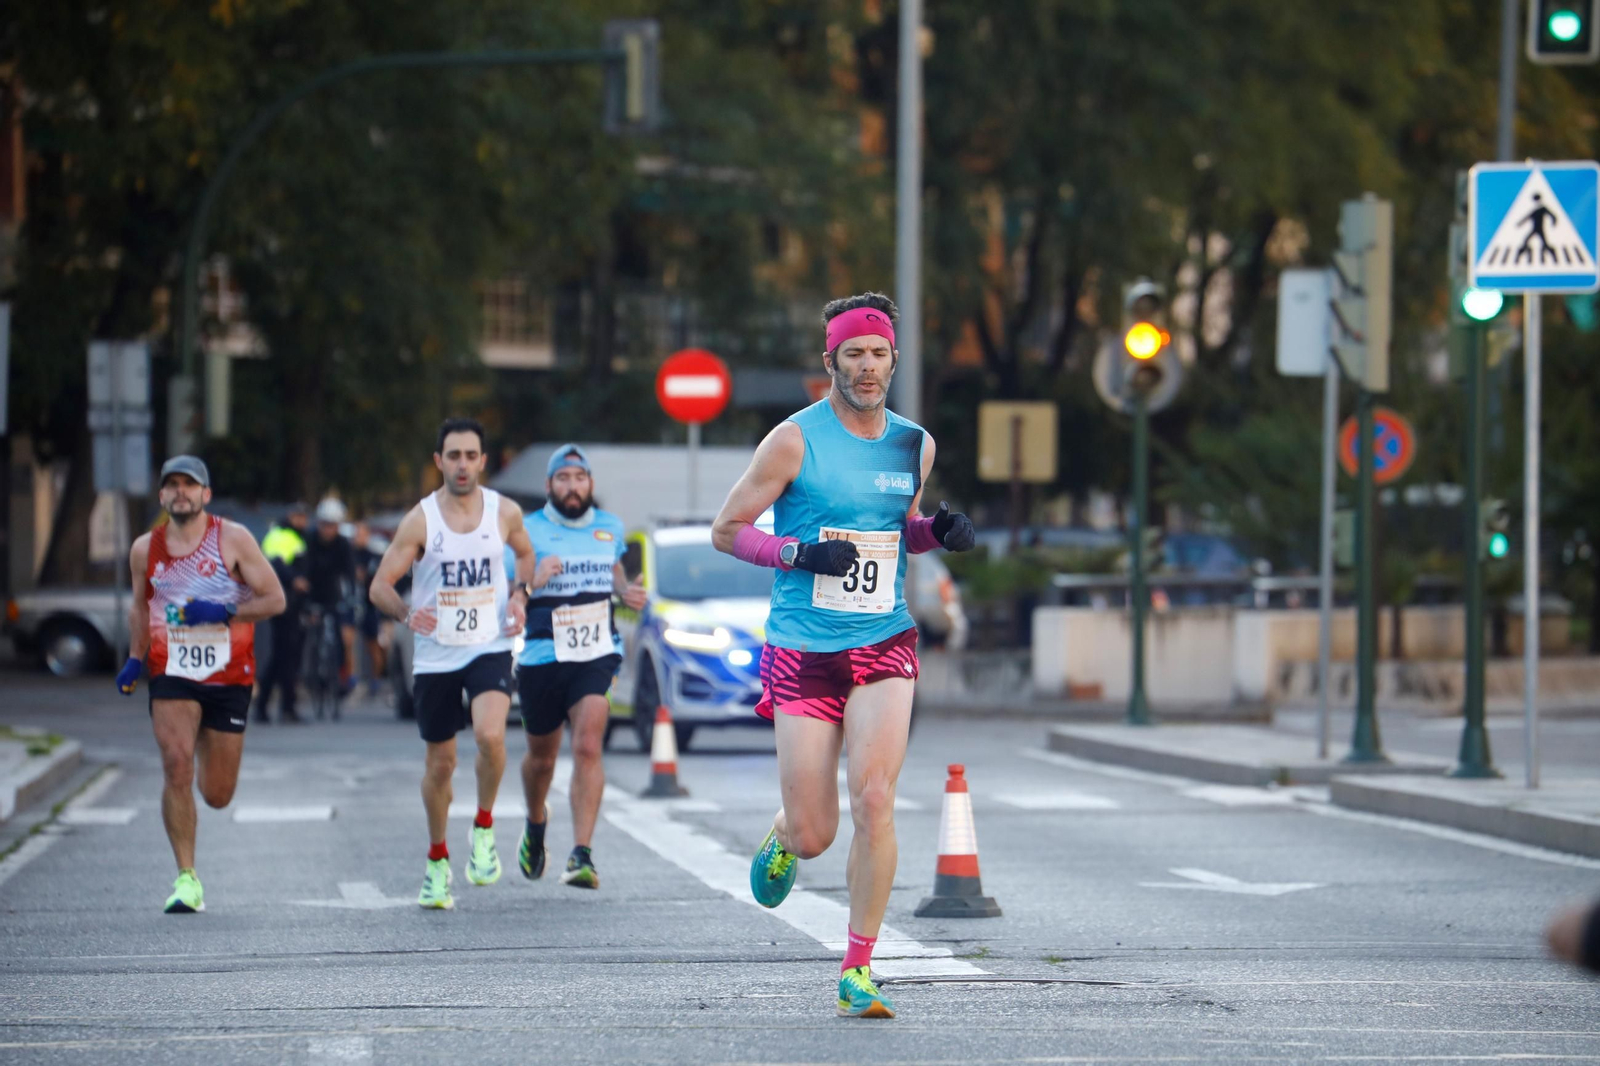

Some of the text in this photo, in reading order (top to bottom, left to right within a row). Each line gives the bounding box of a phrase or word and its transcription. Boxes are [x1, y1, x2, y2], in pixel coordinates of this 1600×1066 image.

[891, 477, 909, 490] kilpi
[441, 559, 490, 587] ENA
[556, 560, 615, 576] tletism
[843, 560, 878, 594] 39
[455, 607, 478, 632] 28
[567, 622, 600, 648] 324
[178, 645, 216, 668] 296
